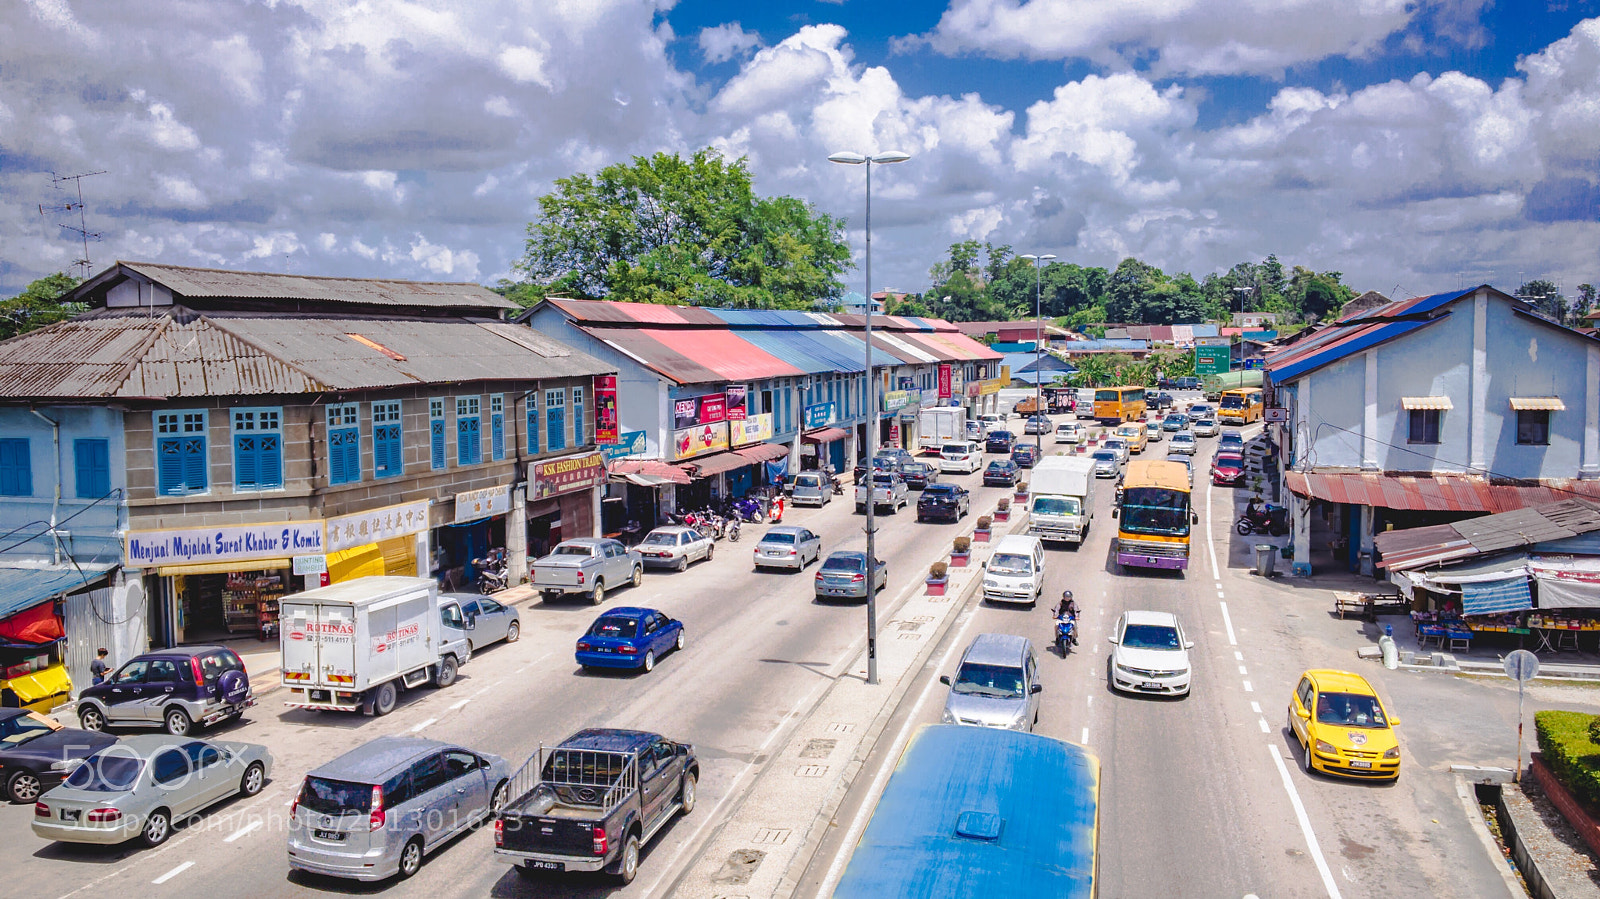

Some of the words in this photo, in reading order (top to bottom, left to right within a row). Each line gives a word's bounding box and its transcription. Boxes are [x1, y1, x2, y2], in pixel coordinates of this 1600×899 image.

[543, 464, 556, 476] KSK
[556, 459, 581, 473] FASHION
[130, 539, 169, 563] Menjual
[173, 536, 212, 560] Majalah
[215, 532, 242, 555] Surat
[245, 531, 278, 552] Khabar
[281, 528, 289, 550] &
[293, 529, 321, 549] Komik
[306, 623, 354, 634] ROTINAS
[387, 625, 418, 640] ROTINAS
